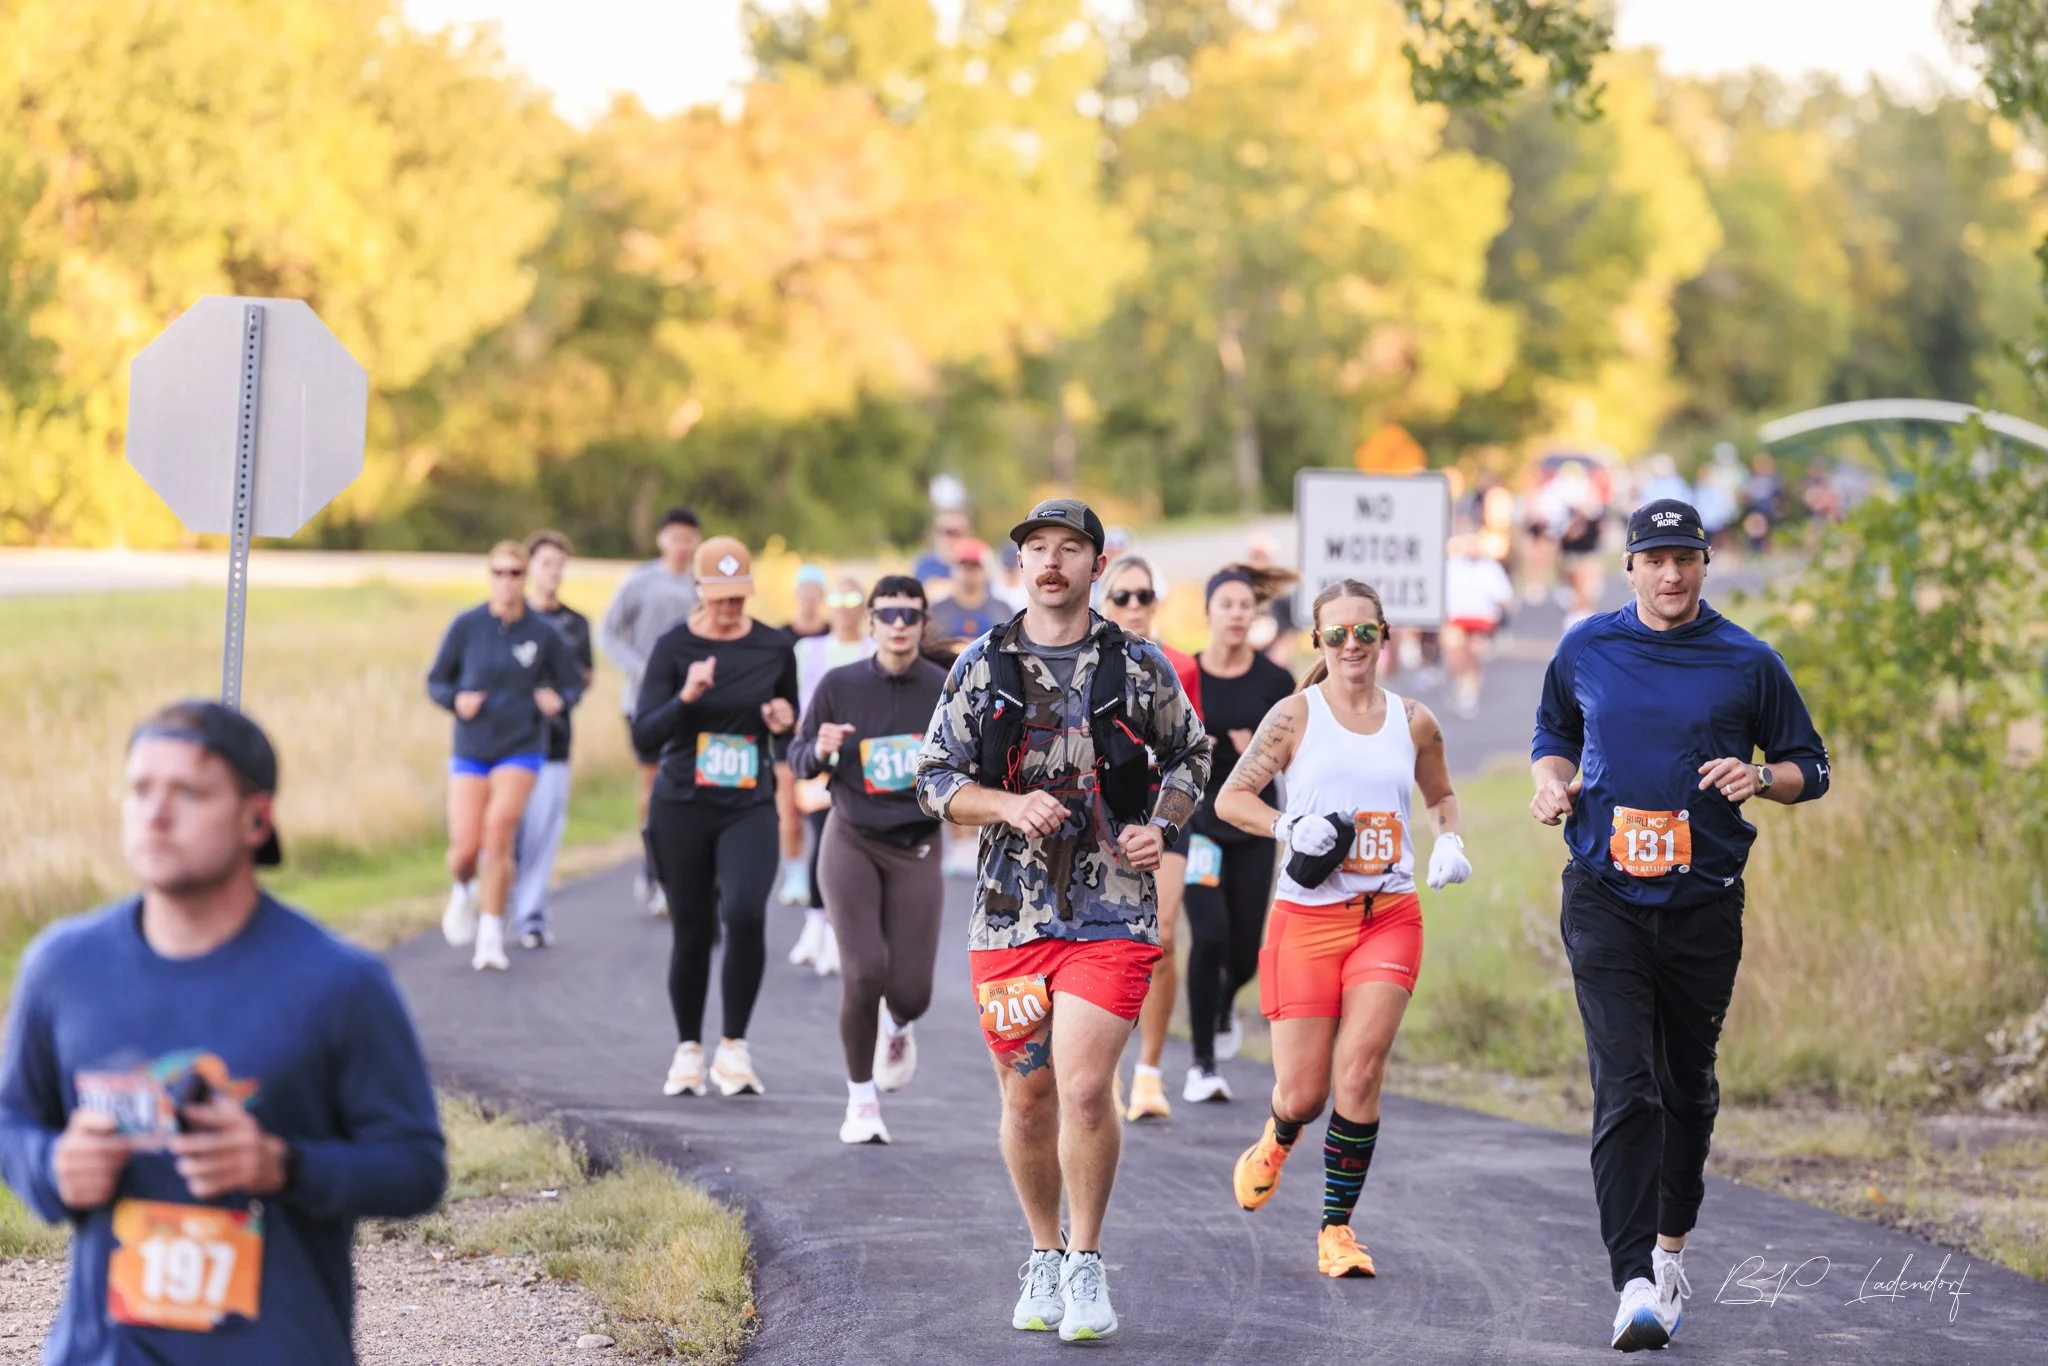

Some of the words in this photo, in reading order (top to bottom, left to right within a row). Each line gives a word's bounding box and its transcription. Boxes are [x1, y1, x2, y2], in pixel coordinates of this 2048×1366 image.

[1355, 494, 1395, 522] NO
[1651, 512, 1664, 522] GO
[1665, 511, 1683, 521] ONE
[1656, 518, 1680, 528] MORE
[1324, 534, 1422, 566] MOTOR
[706, 743, 750, 776] 301
[1623, 828, 1675, 862] 131
[988, 994, 1048, 1032] 240
[138, 1236, 237, 1306] 197
